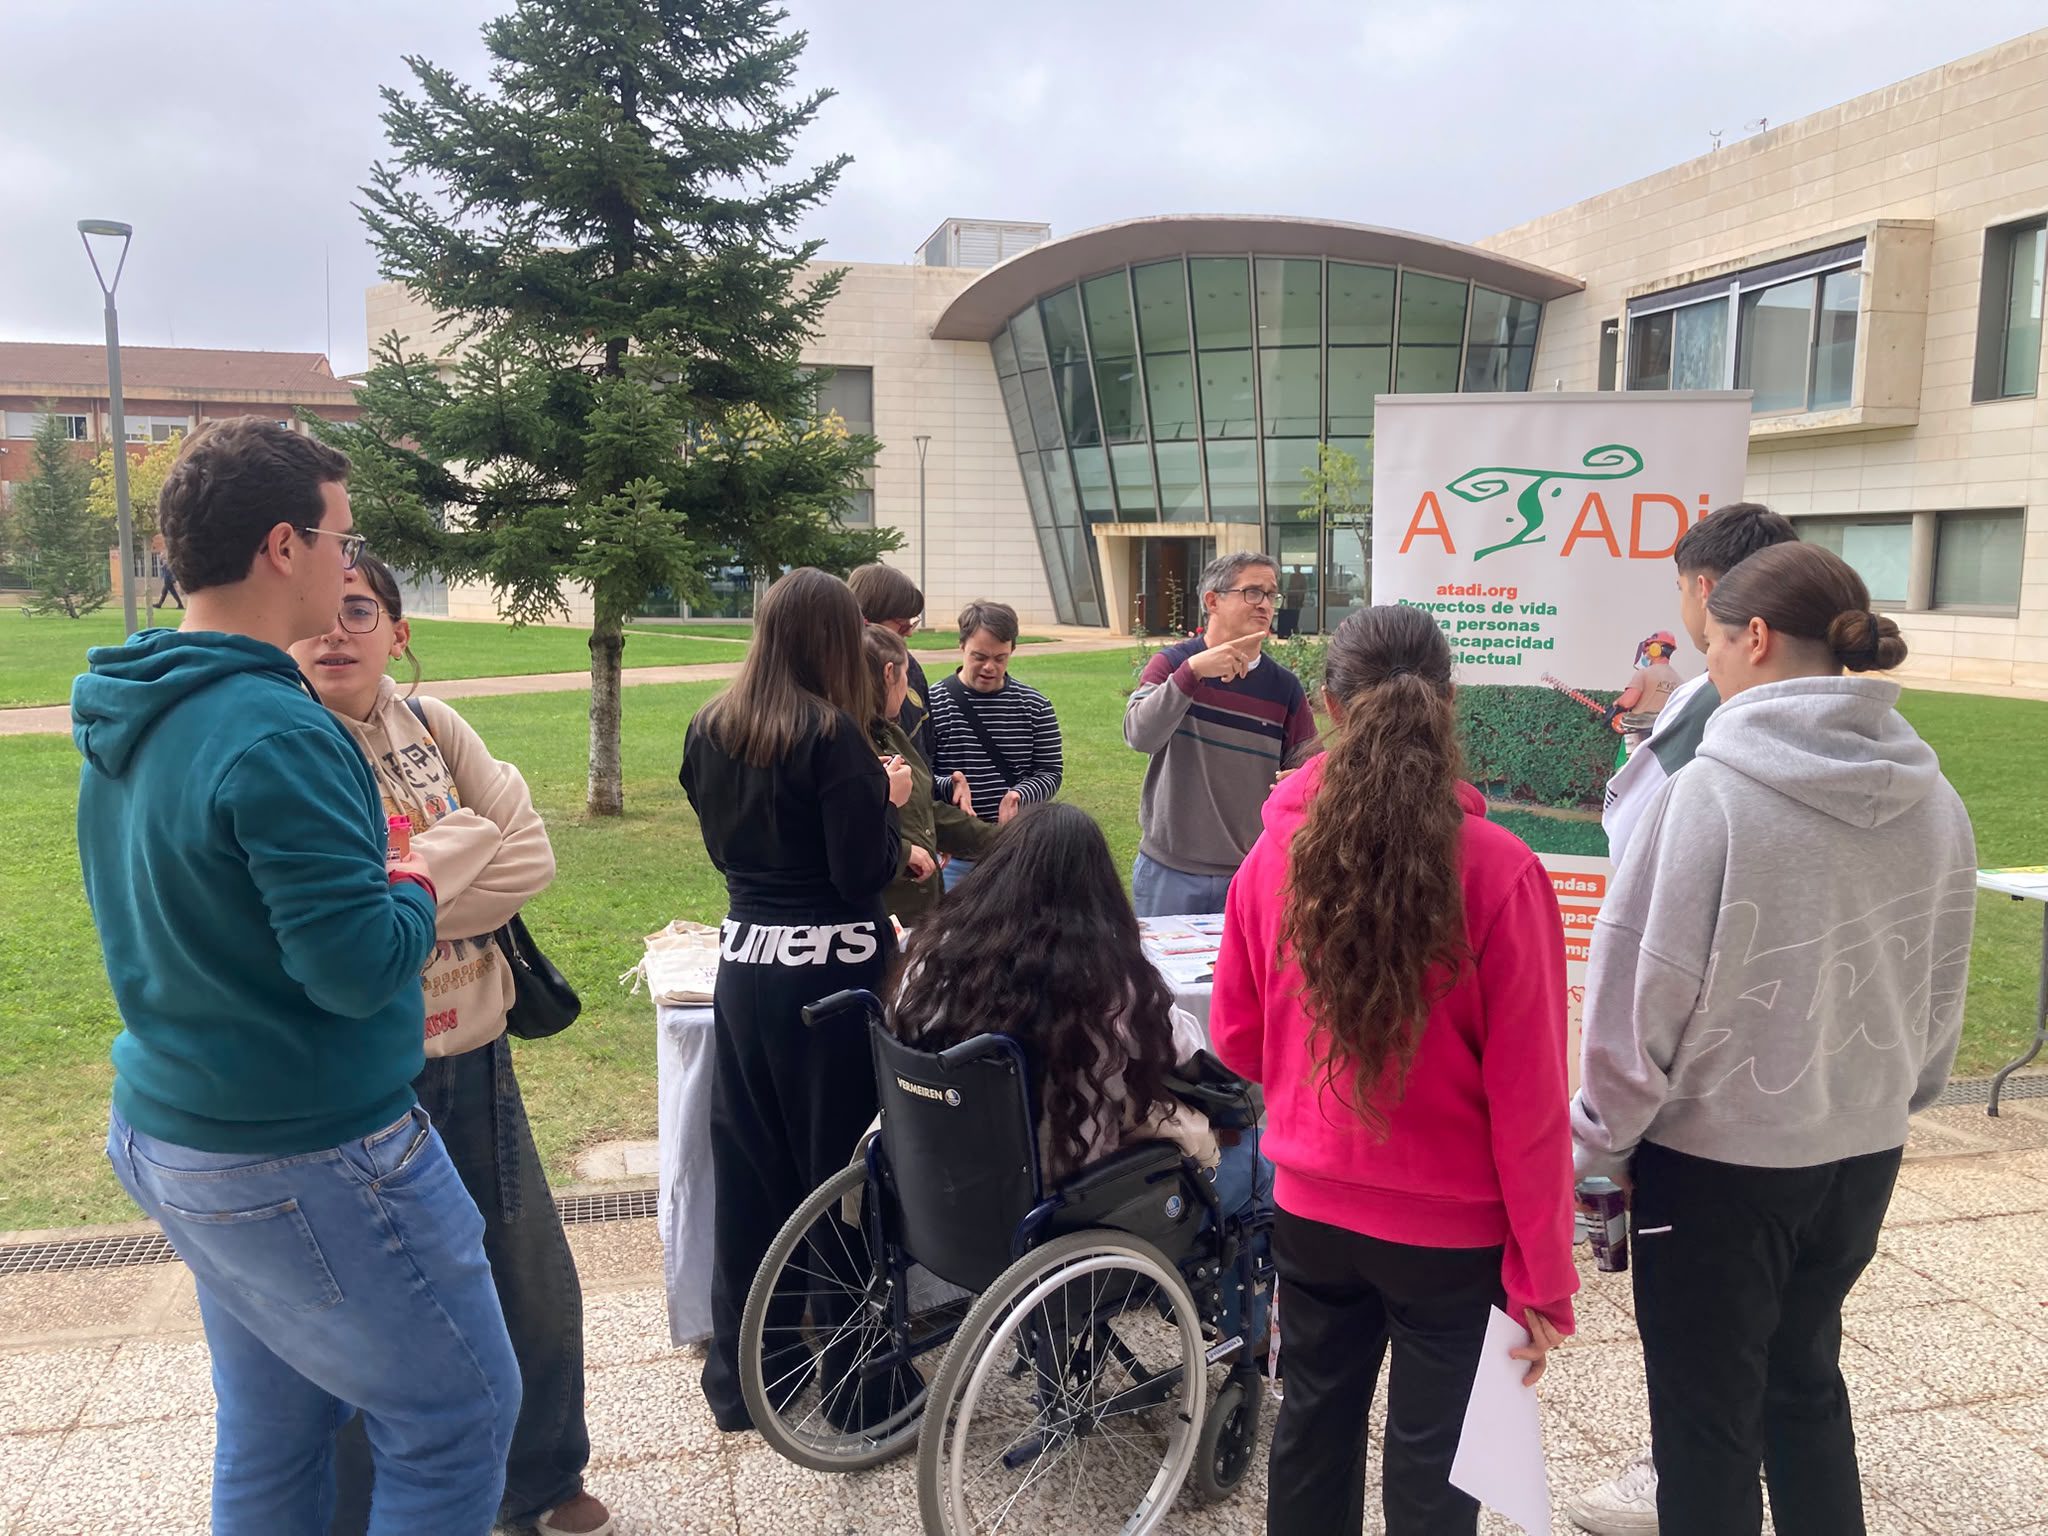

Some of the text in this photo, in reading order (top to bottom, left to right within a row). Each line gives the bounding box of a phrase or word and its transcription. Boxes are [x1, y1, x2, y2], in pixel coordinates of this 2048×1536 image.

[1436, 584, 1518, 600] atadi.org
[1491, 602, 1514, 614] de
[1520, 602, 1558, 616] vida
[1456, 620, 1540, 633] personas
[1445, 635, 1555, 650] iscapacidad
[1451, 652, 1522, 665] electual
[1553, 878, 1598, 892] ndas
[896, 1076, 943, 1101] VERMEIREN
